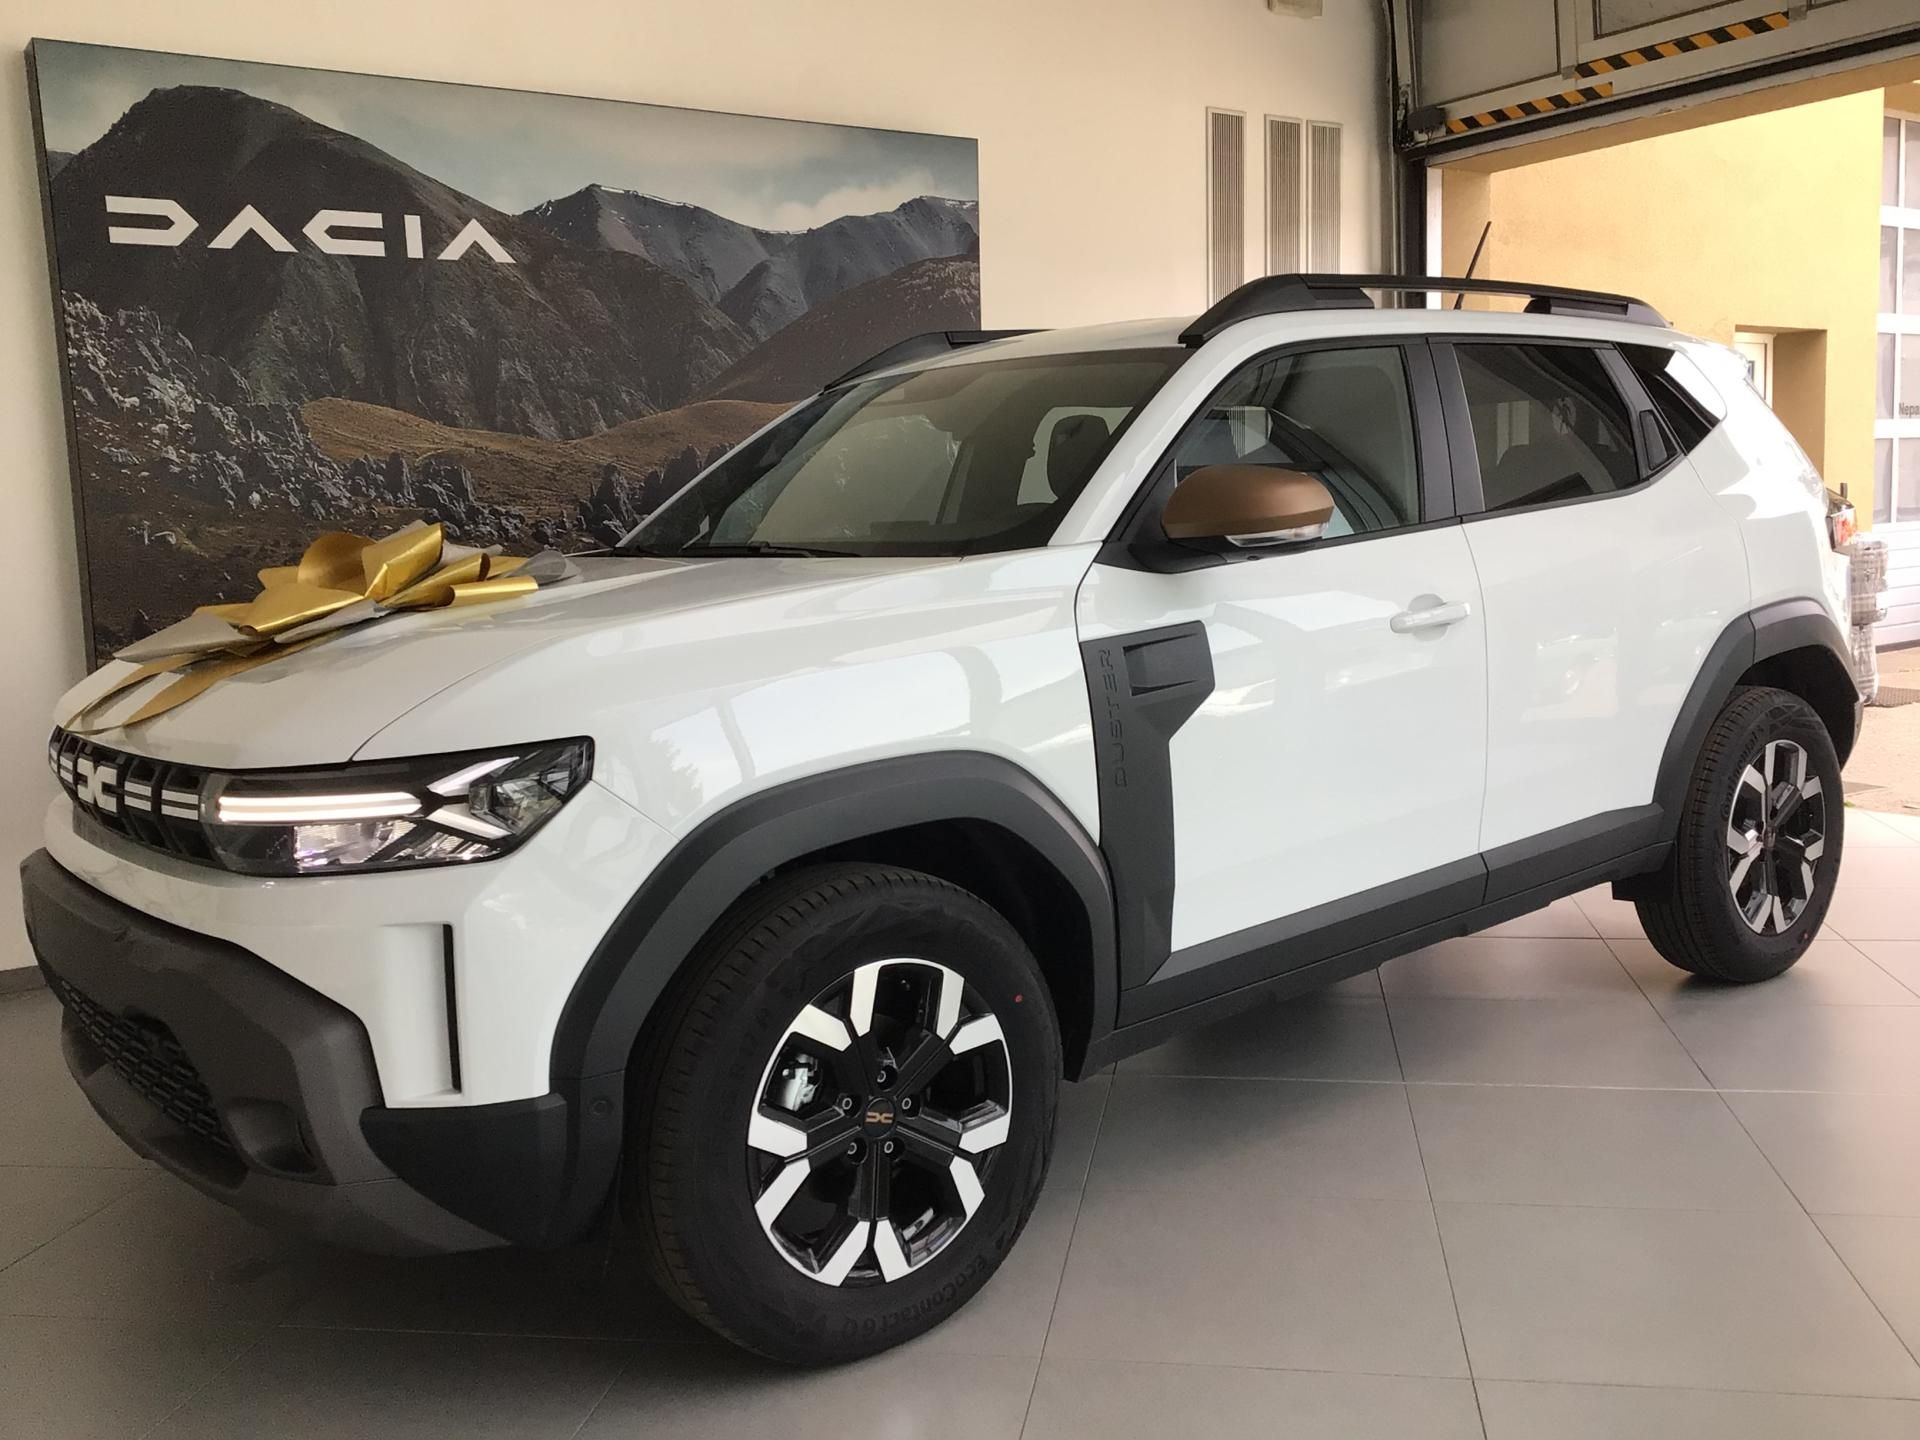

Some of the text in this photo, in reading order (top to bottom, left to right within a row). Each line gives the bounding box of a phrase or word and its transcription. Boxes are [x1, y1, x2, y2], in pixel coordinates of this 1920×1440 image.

[105, 195, 516, 263] DACIA
[1100, 648, 1128, 788] DUSTER
[881, 1253, 988, 1334] EcoContact
